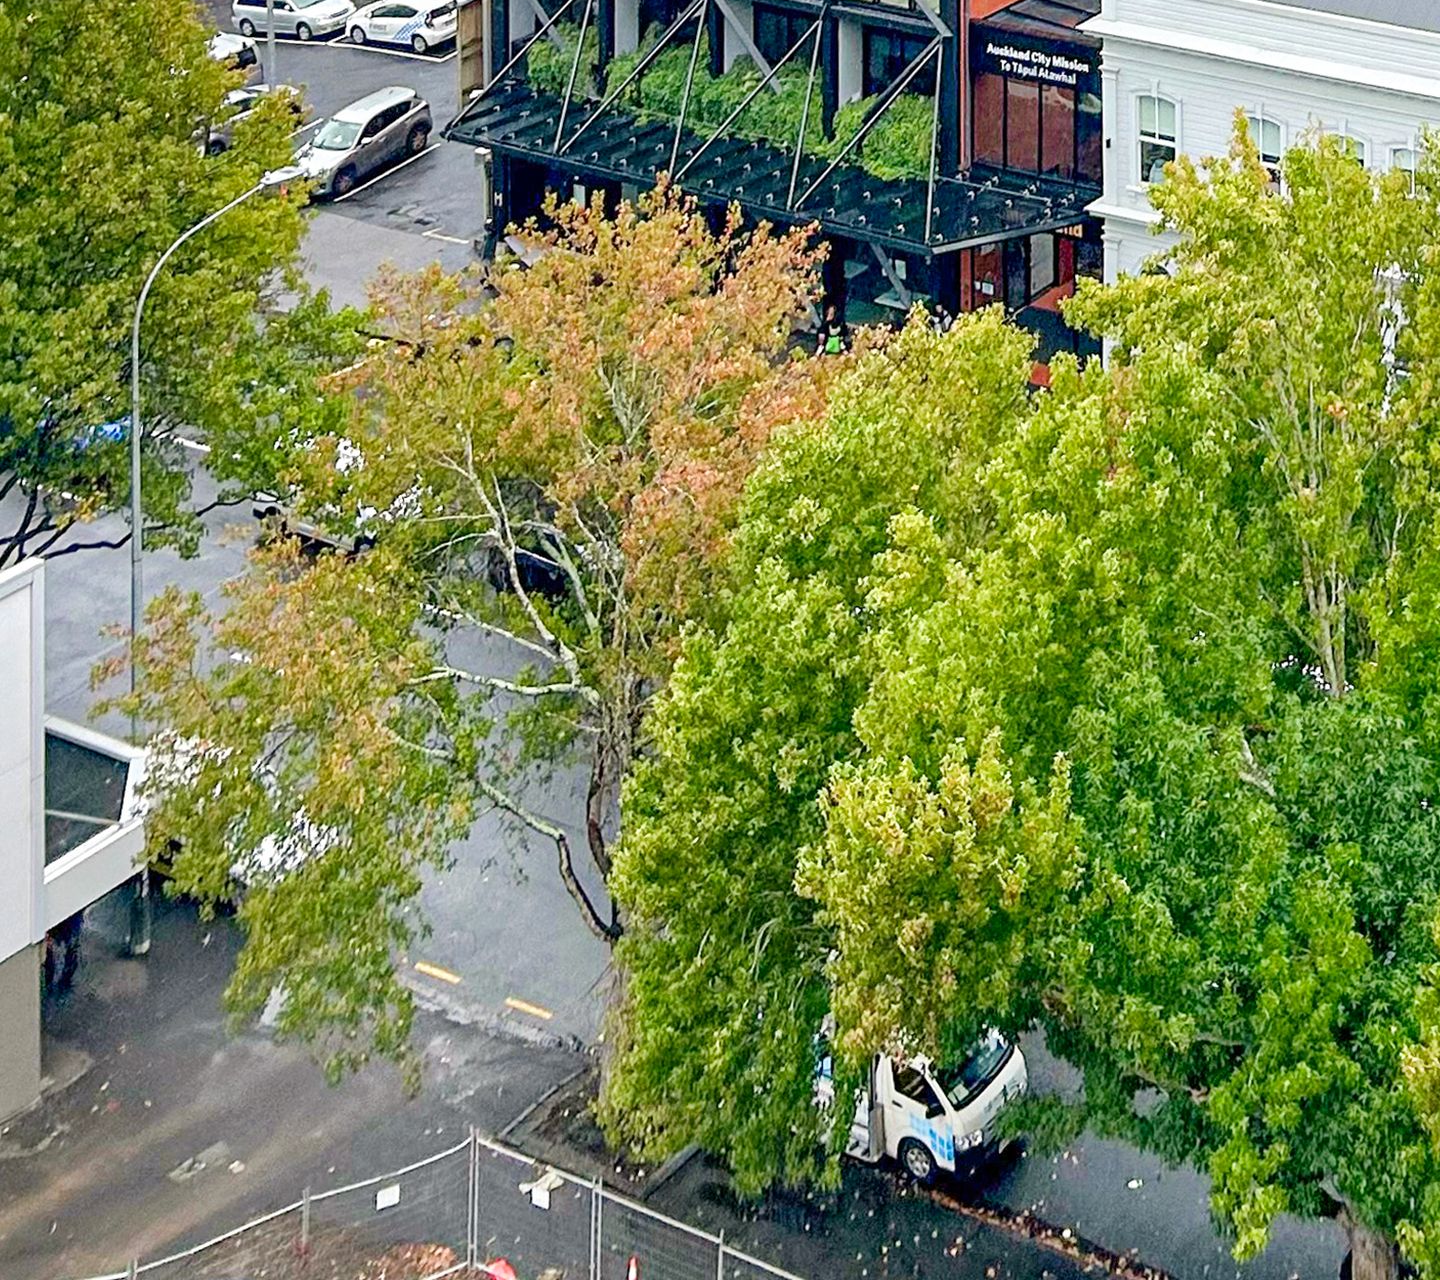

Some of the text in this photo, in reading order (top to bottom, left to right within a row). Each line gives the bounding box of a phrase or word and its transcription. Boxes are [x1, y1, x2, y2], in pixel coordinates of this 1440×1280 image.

[986, 42, 1089, 73] Auckland City Mission
